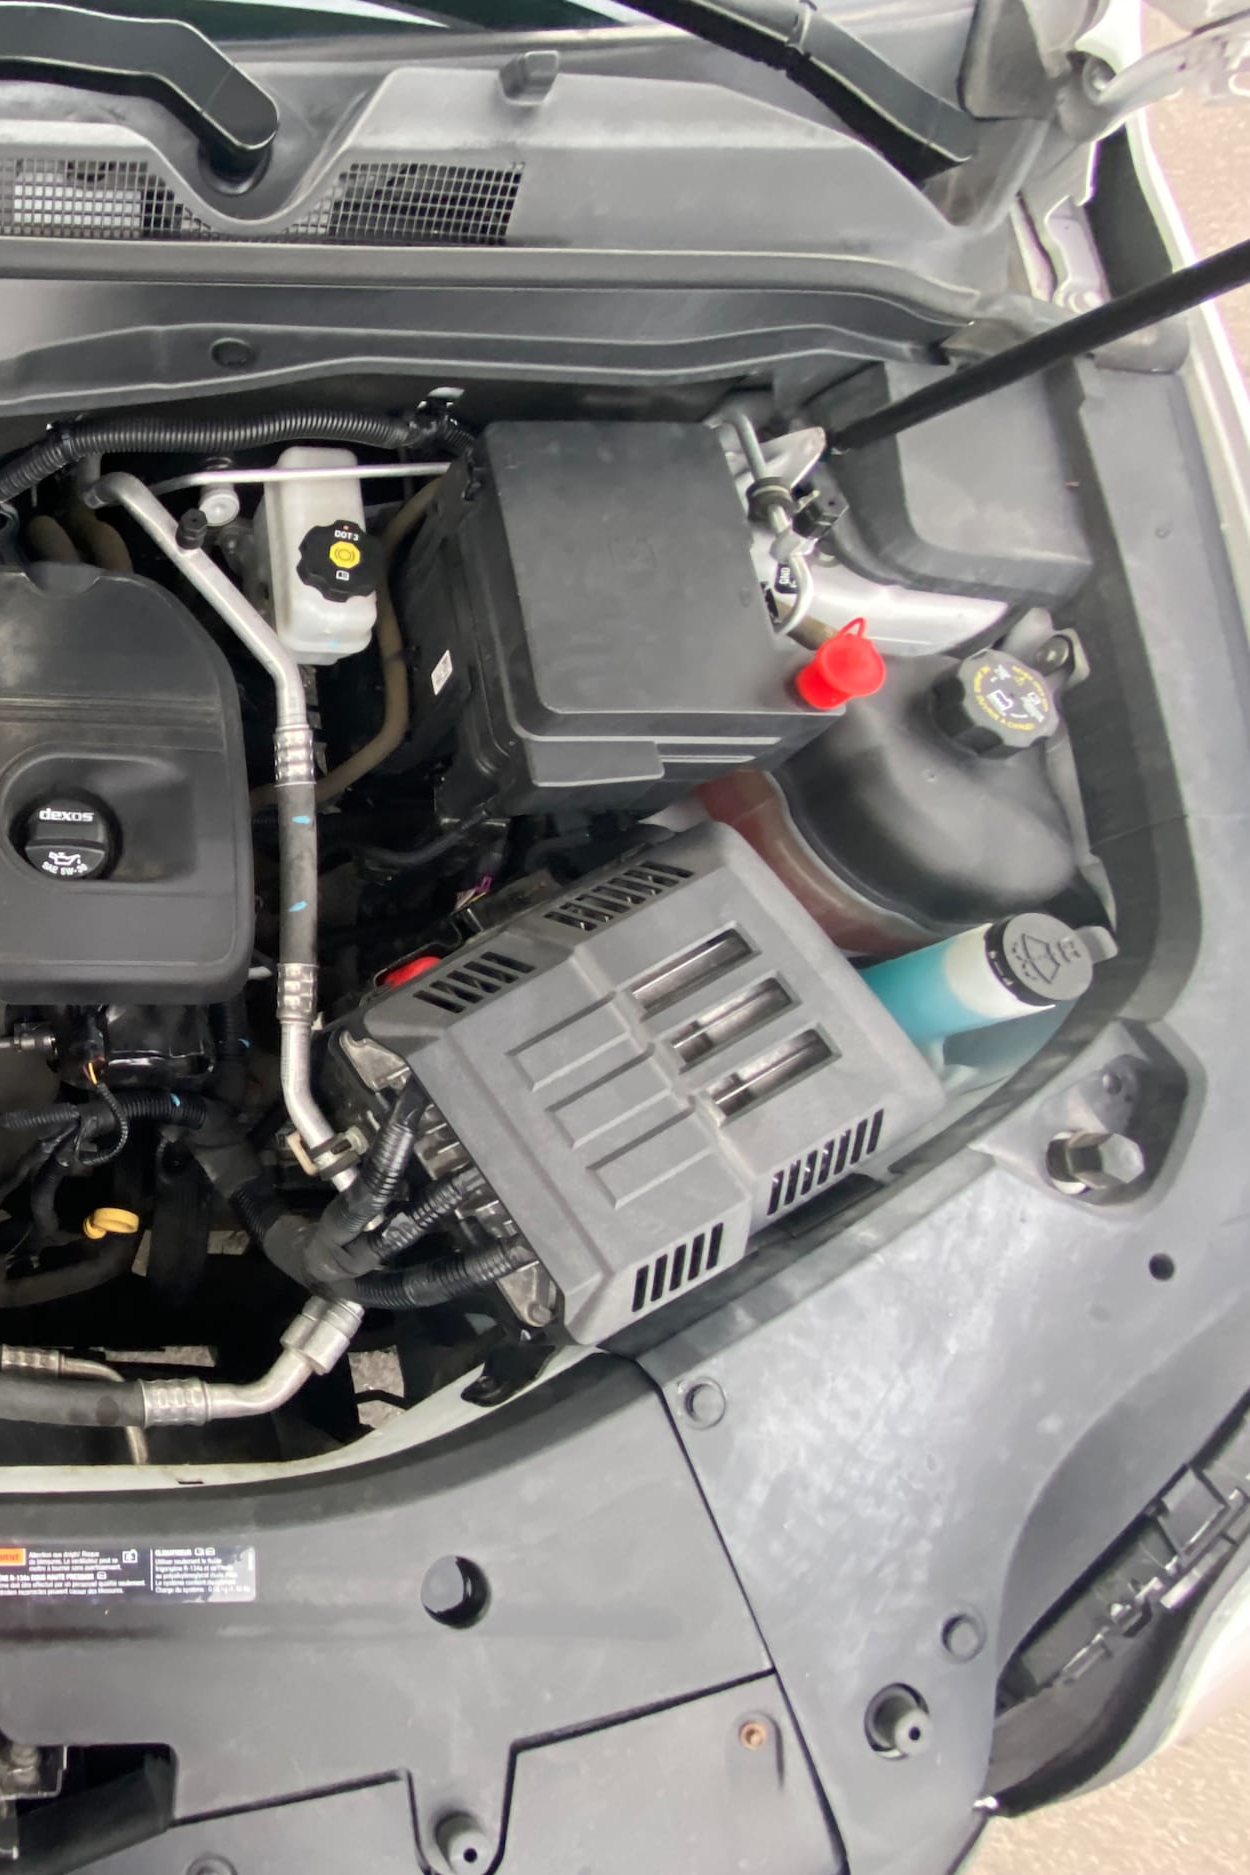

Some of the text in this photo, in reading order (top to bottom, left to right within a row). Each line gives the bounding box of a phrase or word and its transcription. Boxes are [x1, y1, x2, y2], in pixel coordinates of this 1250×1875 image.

[334, 529, 359, 541] DOT 3
[39, 808, 95, 822] dexos
